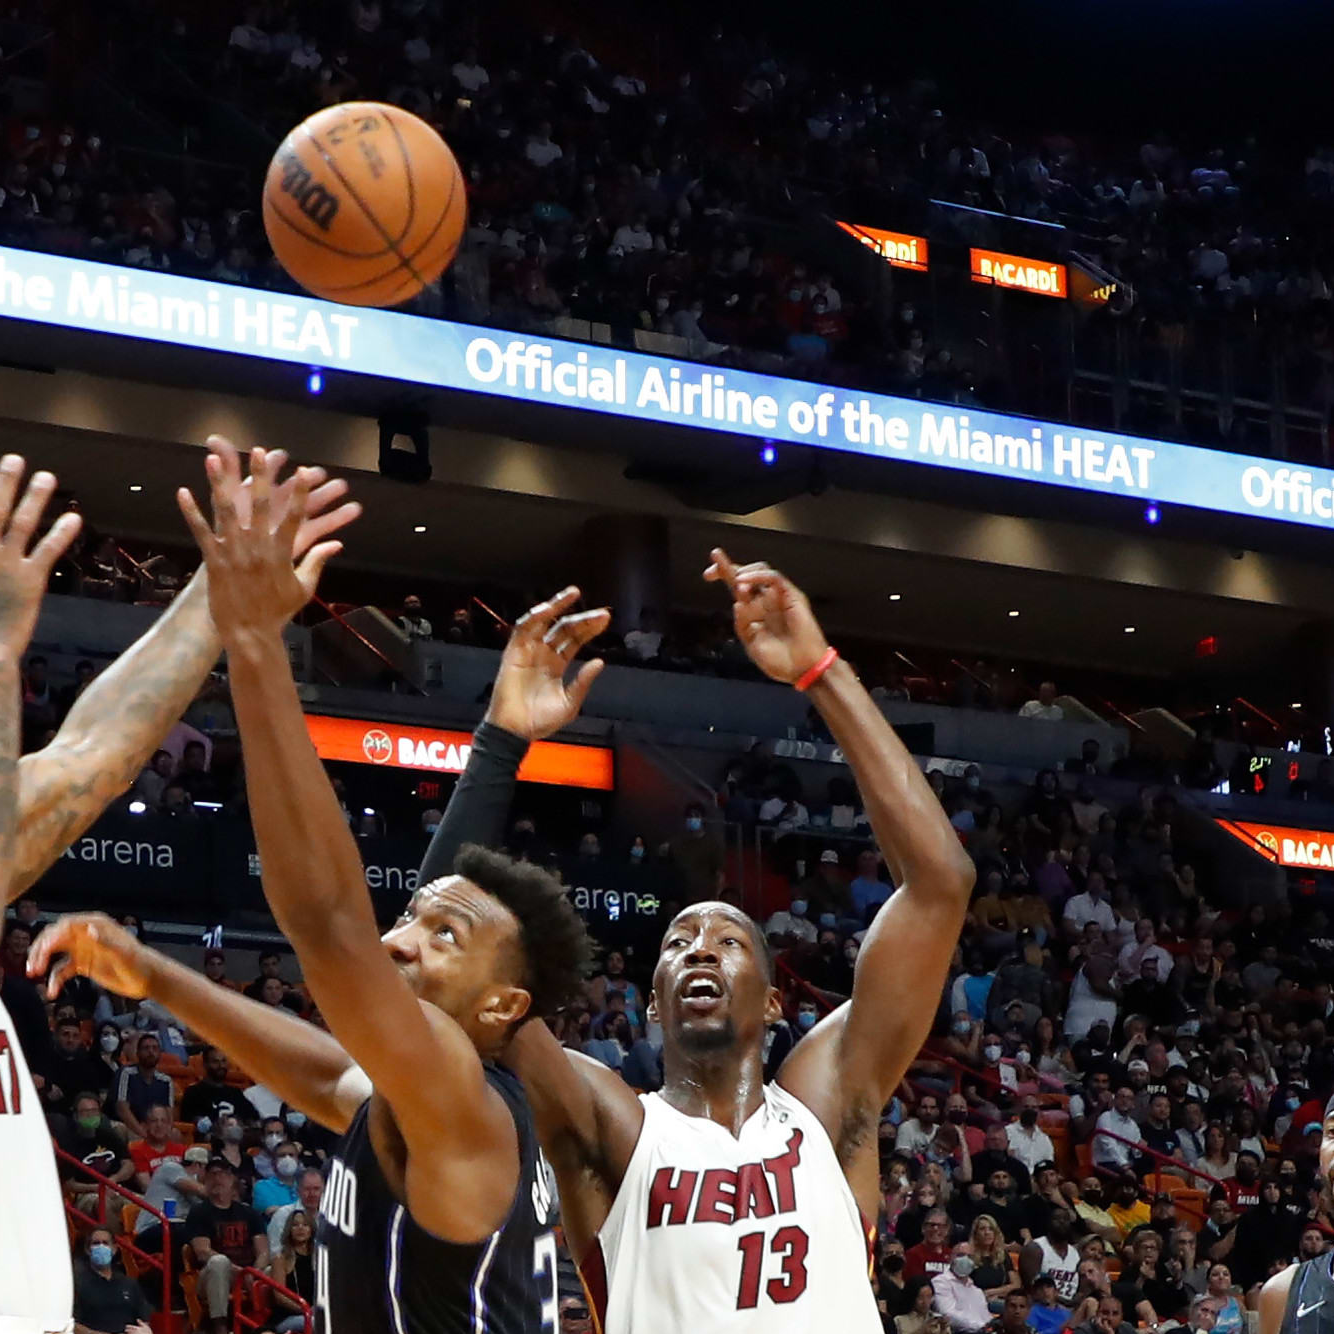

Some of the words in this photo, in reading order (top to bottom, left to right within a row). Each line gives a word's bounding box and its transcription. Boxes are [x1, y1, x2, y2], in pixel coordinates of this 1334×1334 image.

[67, 270, 220, 340] Miami
[233, 298, 359, 360] HEAT
[465, 336, 627, 402] Official
[636, 363, 777, 430] Airline
[788, 396, 834, 437] of
[841, 400, 910, 451] the
[918, 413, 1042, 472] Miami
[1053, 435, 1156, 489] HEAT
[397, 737, 474, 778] BACAR
[83, 837, 175, 868] arena
[365, 862, 421, 893] ena
[646, 1128, 804, 1230] HEAT
[735, 1225, 809, 1311] 13
